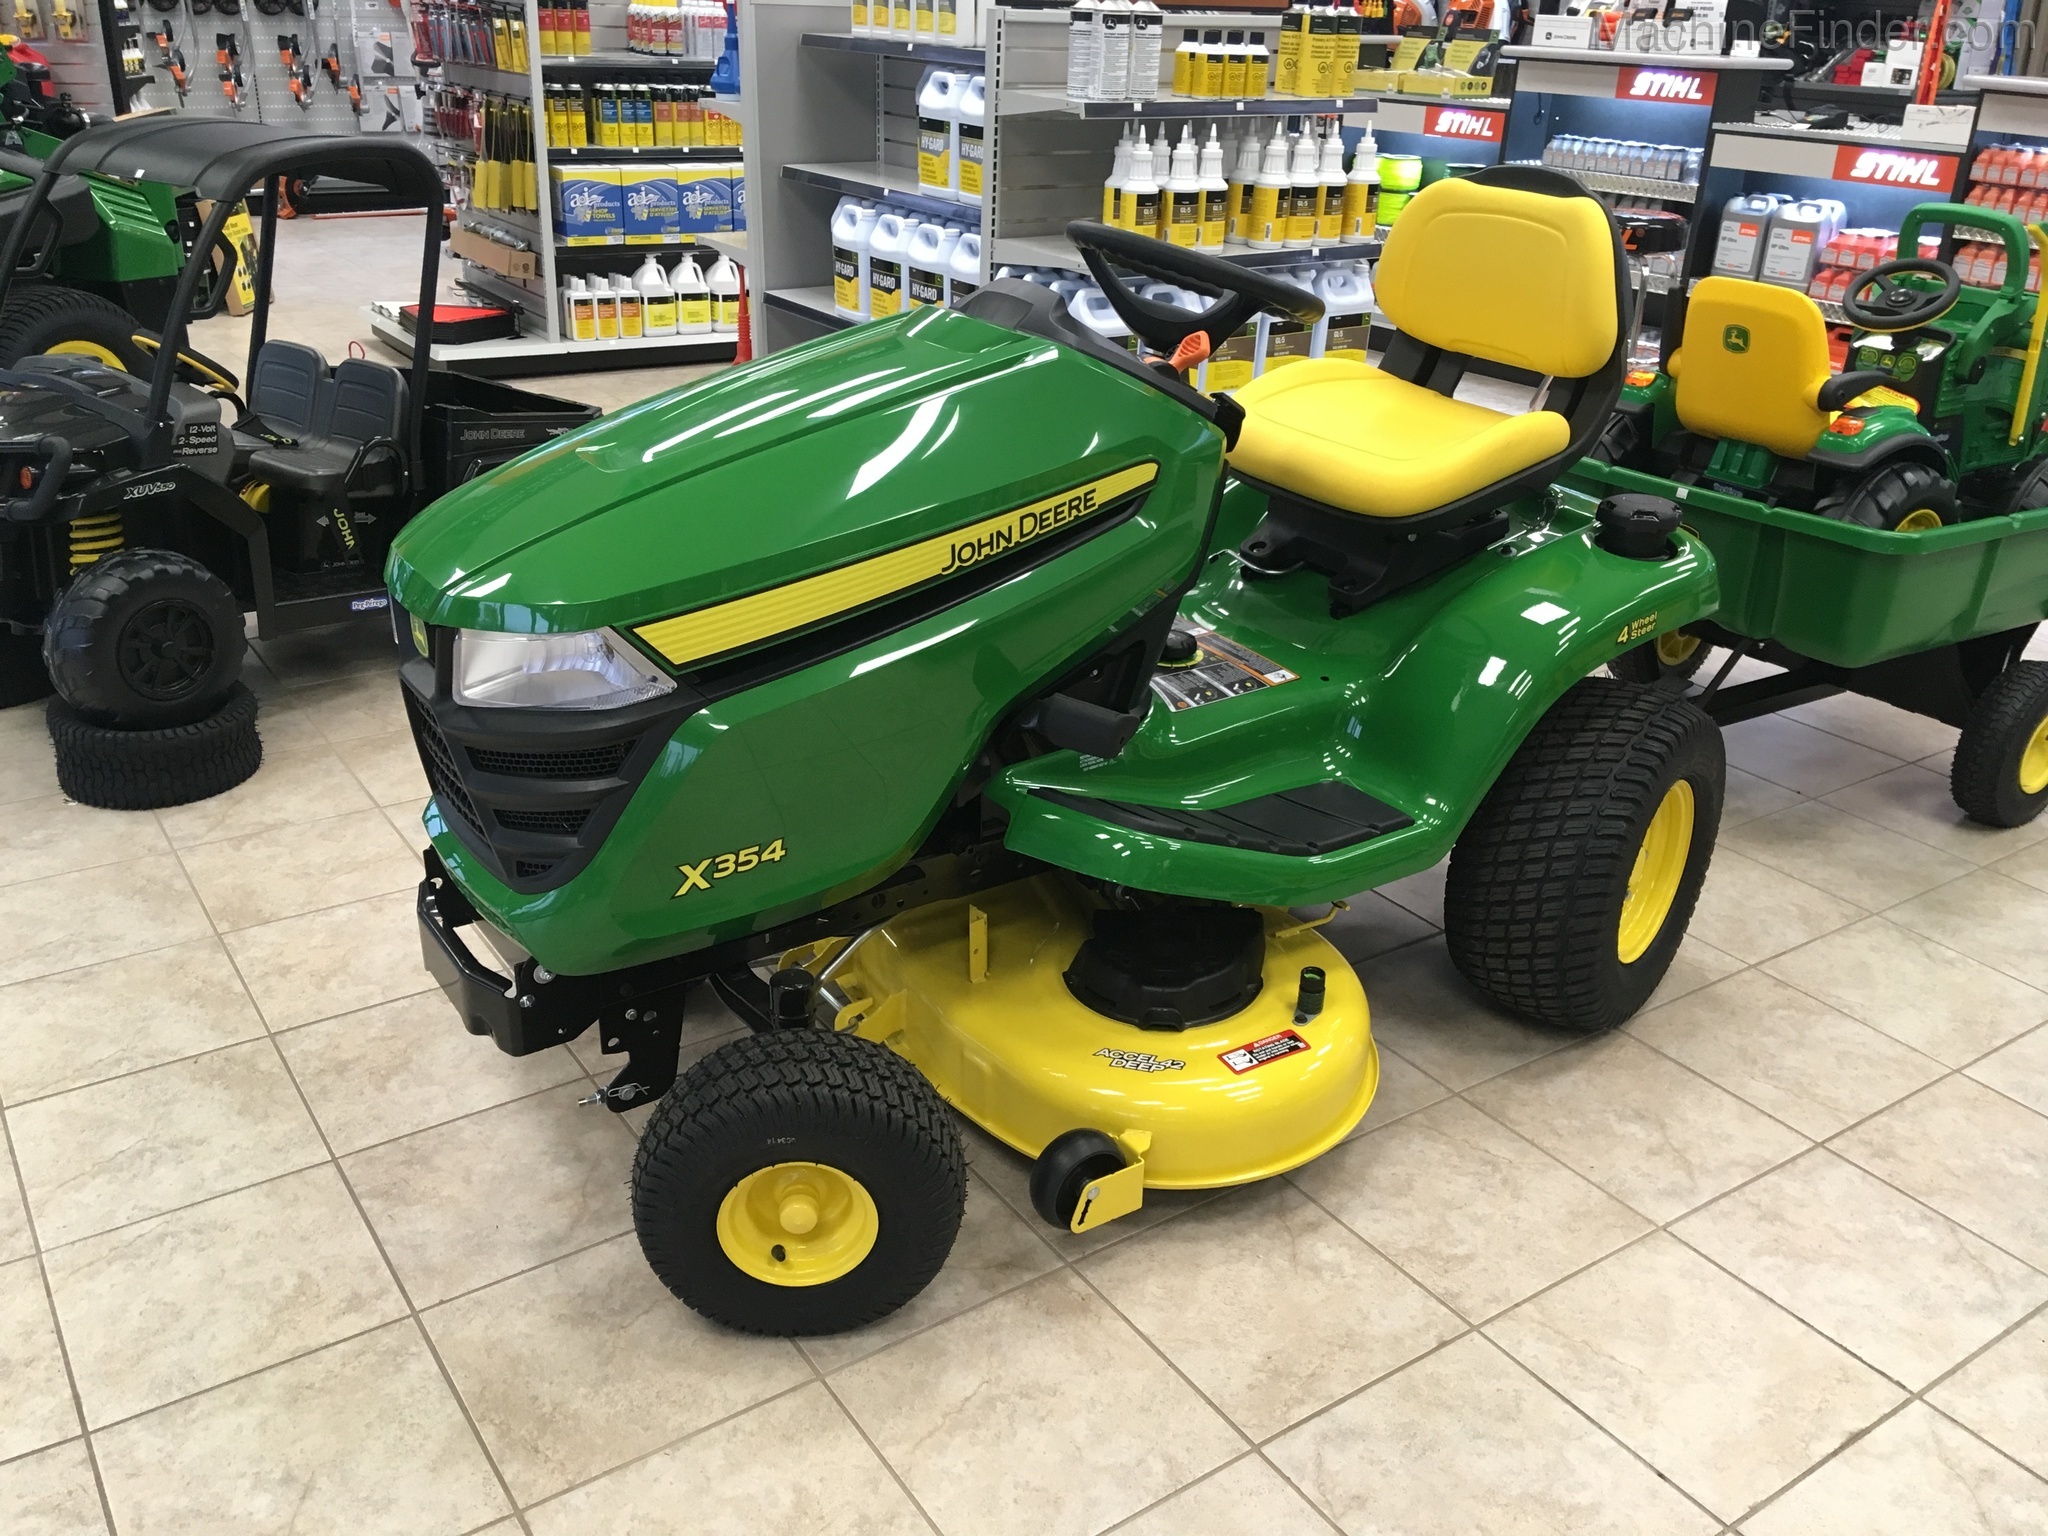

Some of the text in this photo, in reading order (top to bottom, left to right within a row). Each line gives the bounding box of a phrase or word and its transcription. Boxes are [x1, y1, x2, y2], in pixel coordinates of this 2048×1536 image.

[1629, 71, 1702, 100] STIHL
[1434, 111, 1493, 137] STIHL
[921, 135, 944, 152] HY-GARD
[1850, 151, 1940, 186] STIHL
[835, 261, 855, 278] HY-GARD
[872, 272, 896, 290] HY-GARD
[911, 282, 938, 301] HY-GARD
[189, 424, 217, 434] 12-Volt
[460, 428, 525, 441] JOHN DEERE
[178, 434, 217, 445] 2-Speed
[182, 446, 218, 456] Reverse
[941, 488, 1097, 573] JOHN DEERE
[1616, 610, 1658, 644] 4 Wheel
[1630, 622, 1656, 640] Steer
[673, 838, 787, 899] X354
[1093, 1047, 1186, 1071] ACCEL 42
[1109, 1057, 1167, 1074] DEEP
